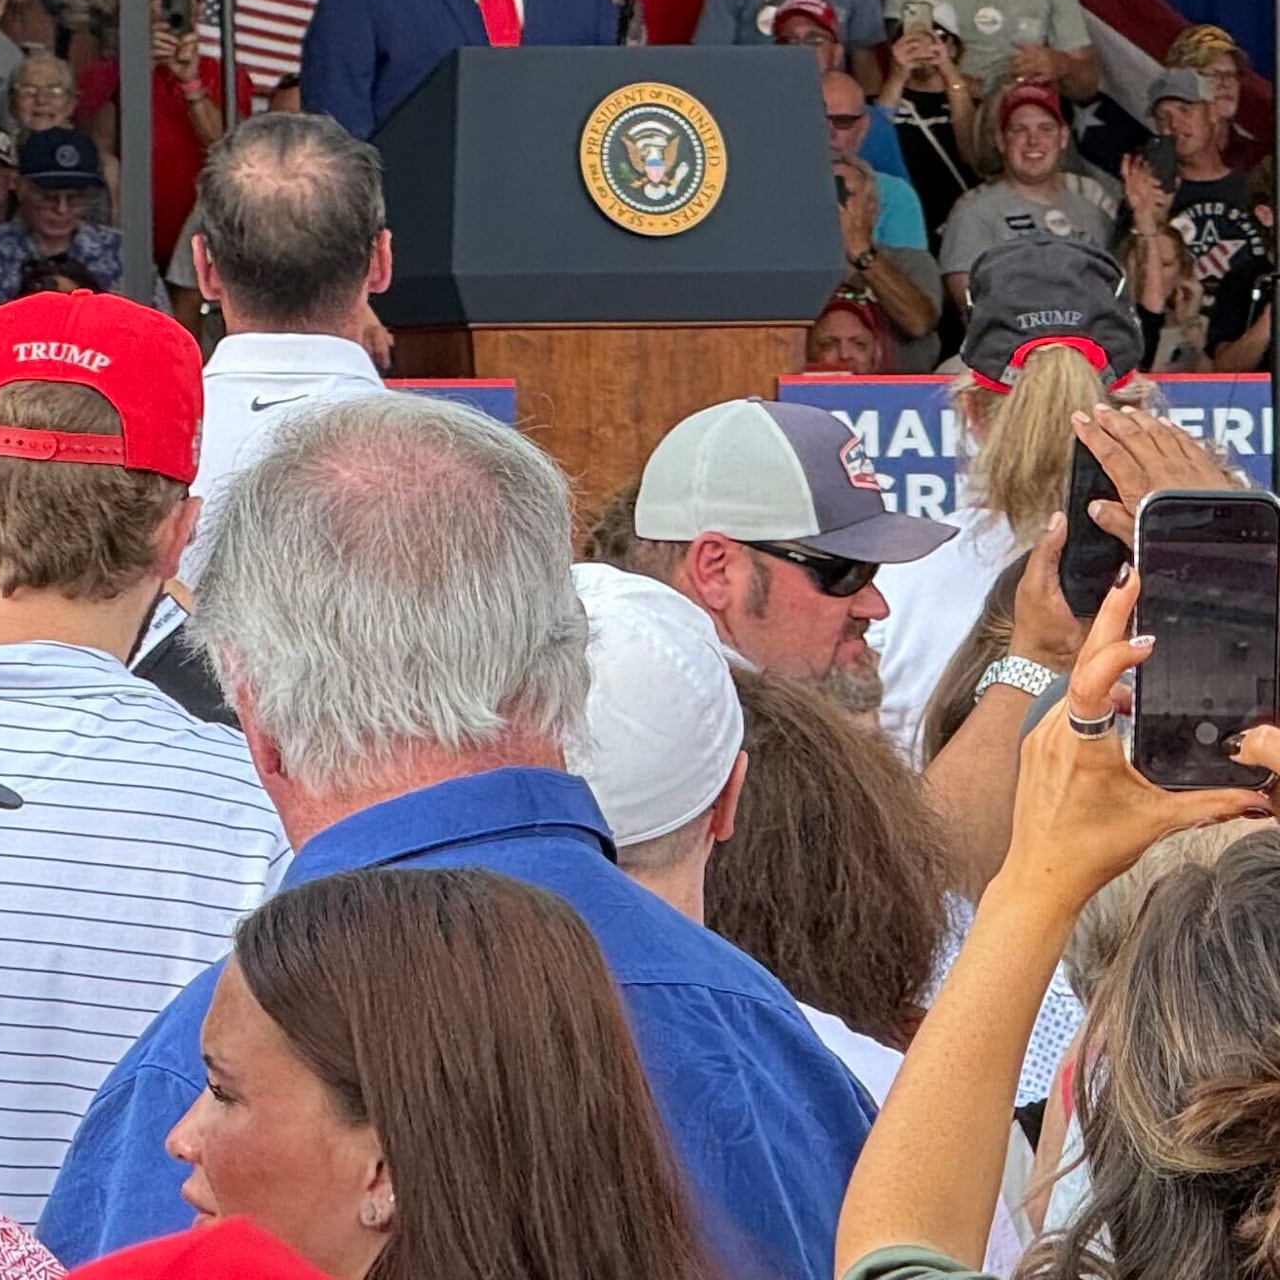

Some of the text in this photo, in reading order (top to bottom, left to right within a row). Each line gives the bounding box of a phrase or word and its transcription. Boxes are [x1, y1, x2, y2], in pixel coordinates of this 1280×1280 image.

[649, 89, 663, 100] OF
[666, 93, 686, 108] THE
[586, 88, 647, 156] PRESIDENT
[687, 105, 721, 168] UNITED
[609, 195, 647, 227] SEAL
[671, 179, 718, 228] STATES
[1016, 309, 1083, 330] TRUMP
[12, 341, 113, 374] TRUMP
[830, 409, 982, 458] MAK
